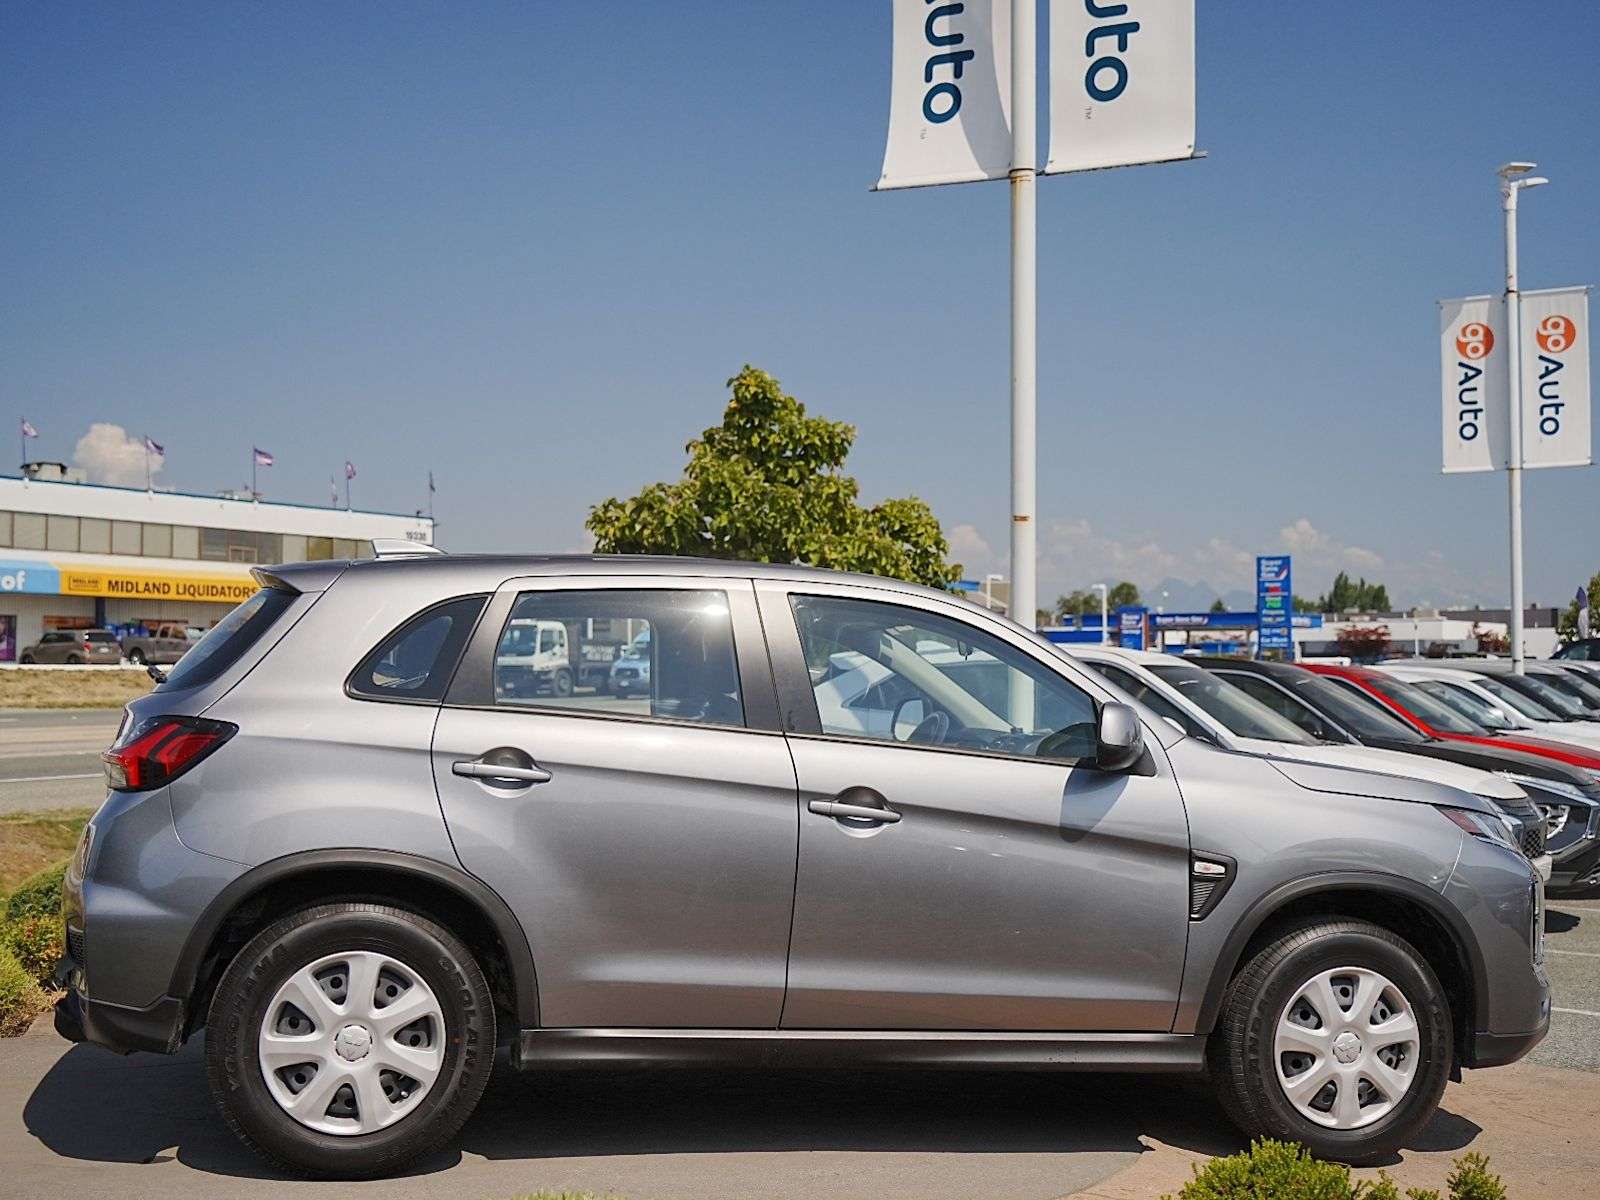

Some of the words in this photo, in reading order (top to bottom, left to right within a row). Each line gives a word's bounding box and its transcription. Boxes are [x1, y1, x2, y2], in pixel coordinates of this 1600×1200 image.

[922, 0, 975, 124] uto
[1458, 361, 1483, 441] Auto
[1538, 355, 1565, 436] Auto
[107, 579, 171, 595] MIDLAND
[176, 583, 256, 598] LIQUIDATORS
